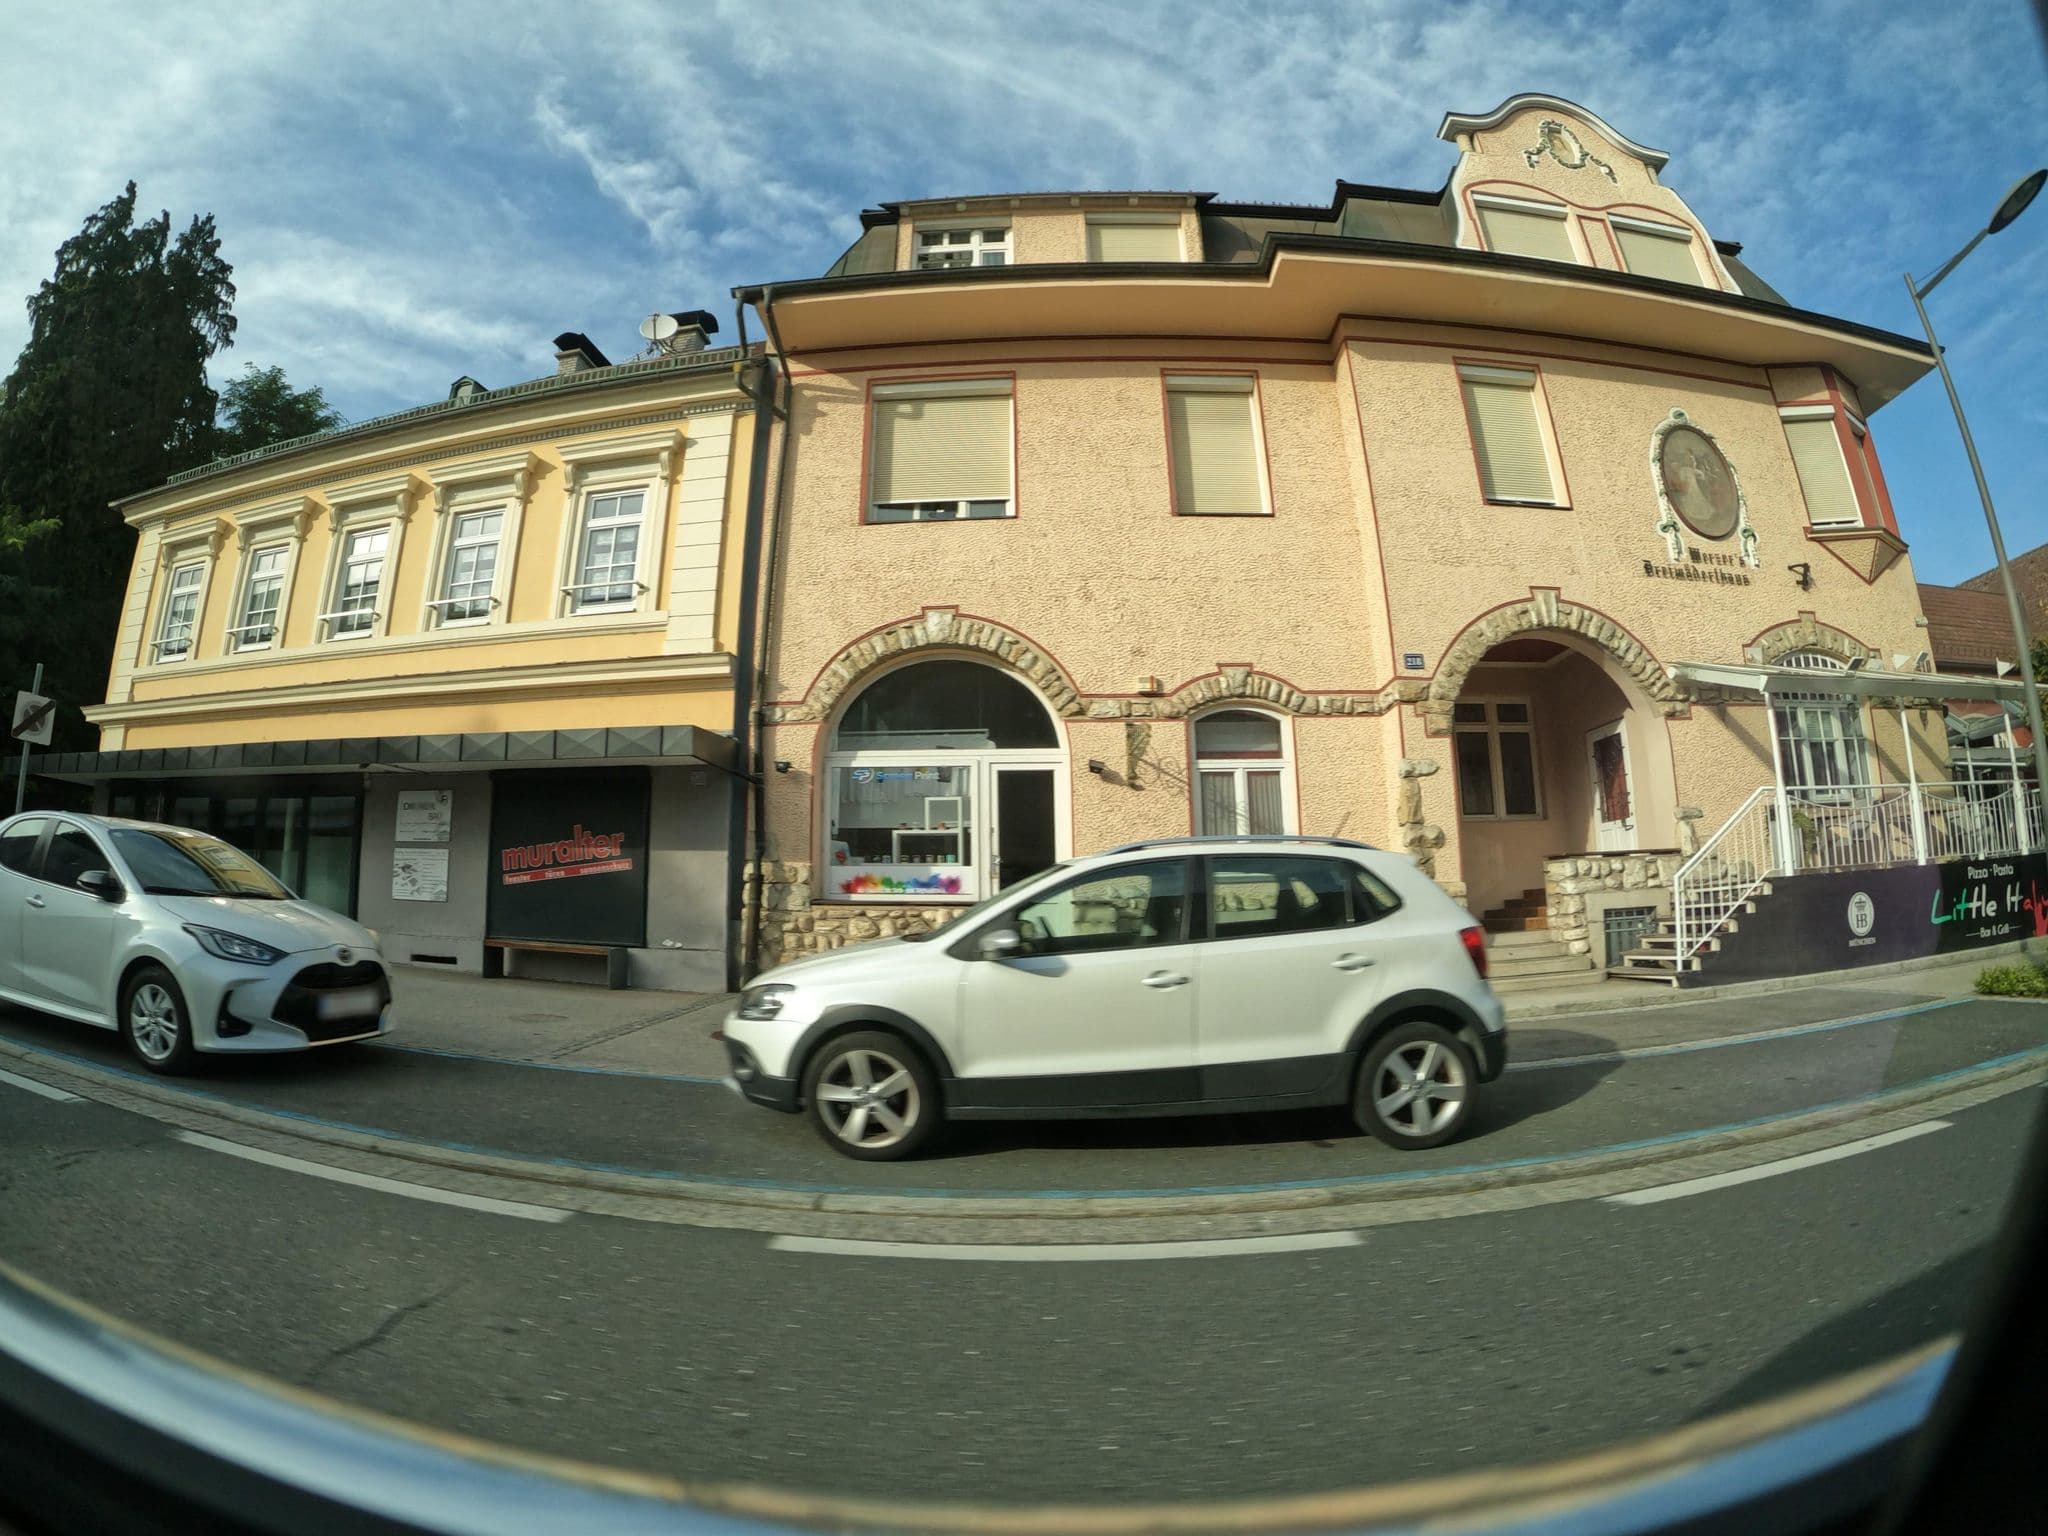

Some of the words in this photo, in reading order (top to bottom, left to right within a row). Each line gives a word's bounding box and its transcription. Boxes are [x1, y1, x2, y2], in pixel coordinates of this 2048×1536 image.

[502, 824, 625, 870] muralter
[1967, 866, 1989, 879] Pizza
[1992, 863, 2015, 876] Pasta
[1931, 883, 1998, 925] Little
[1980, 927, 1991, 938] Bar
